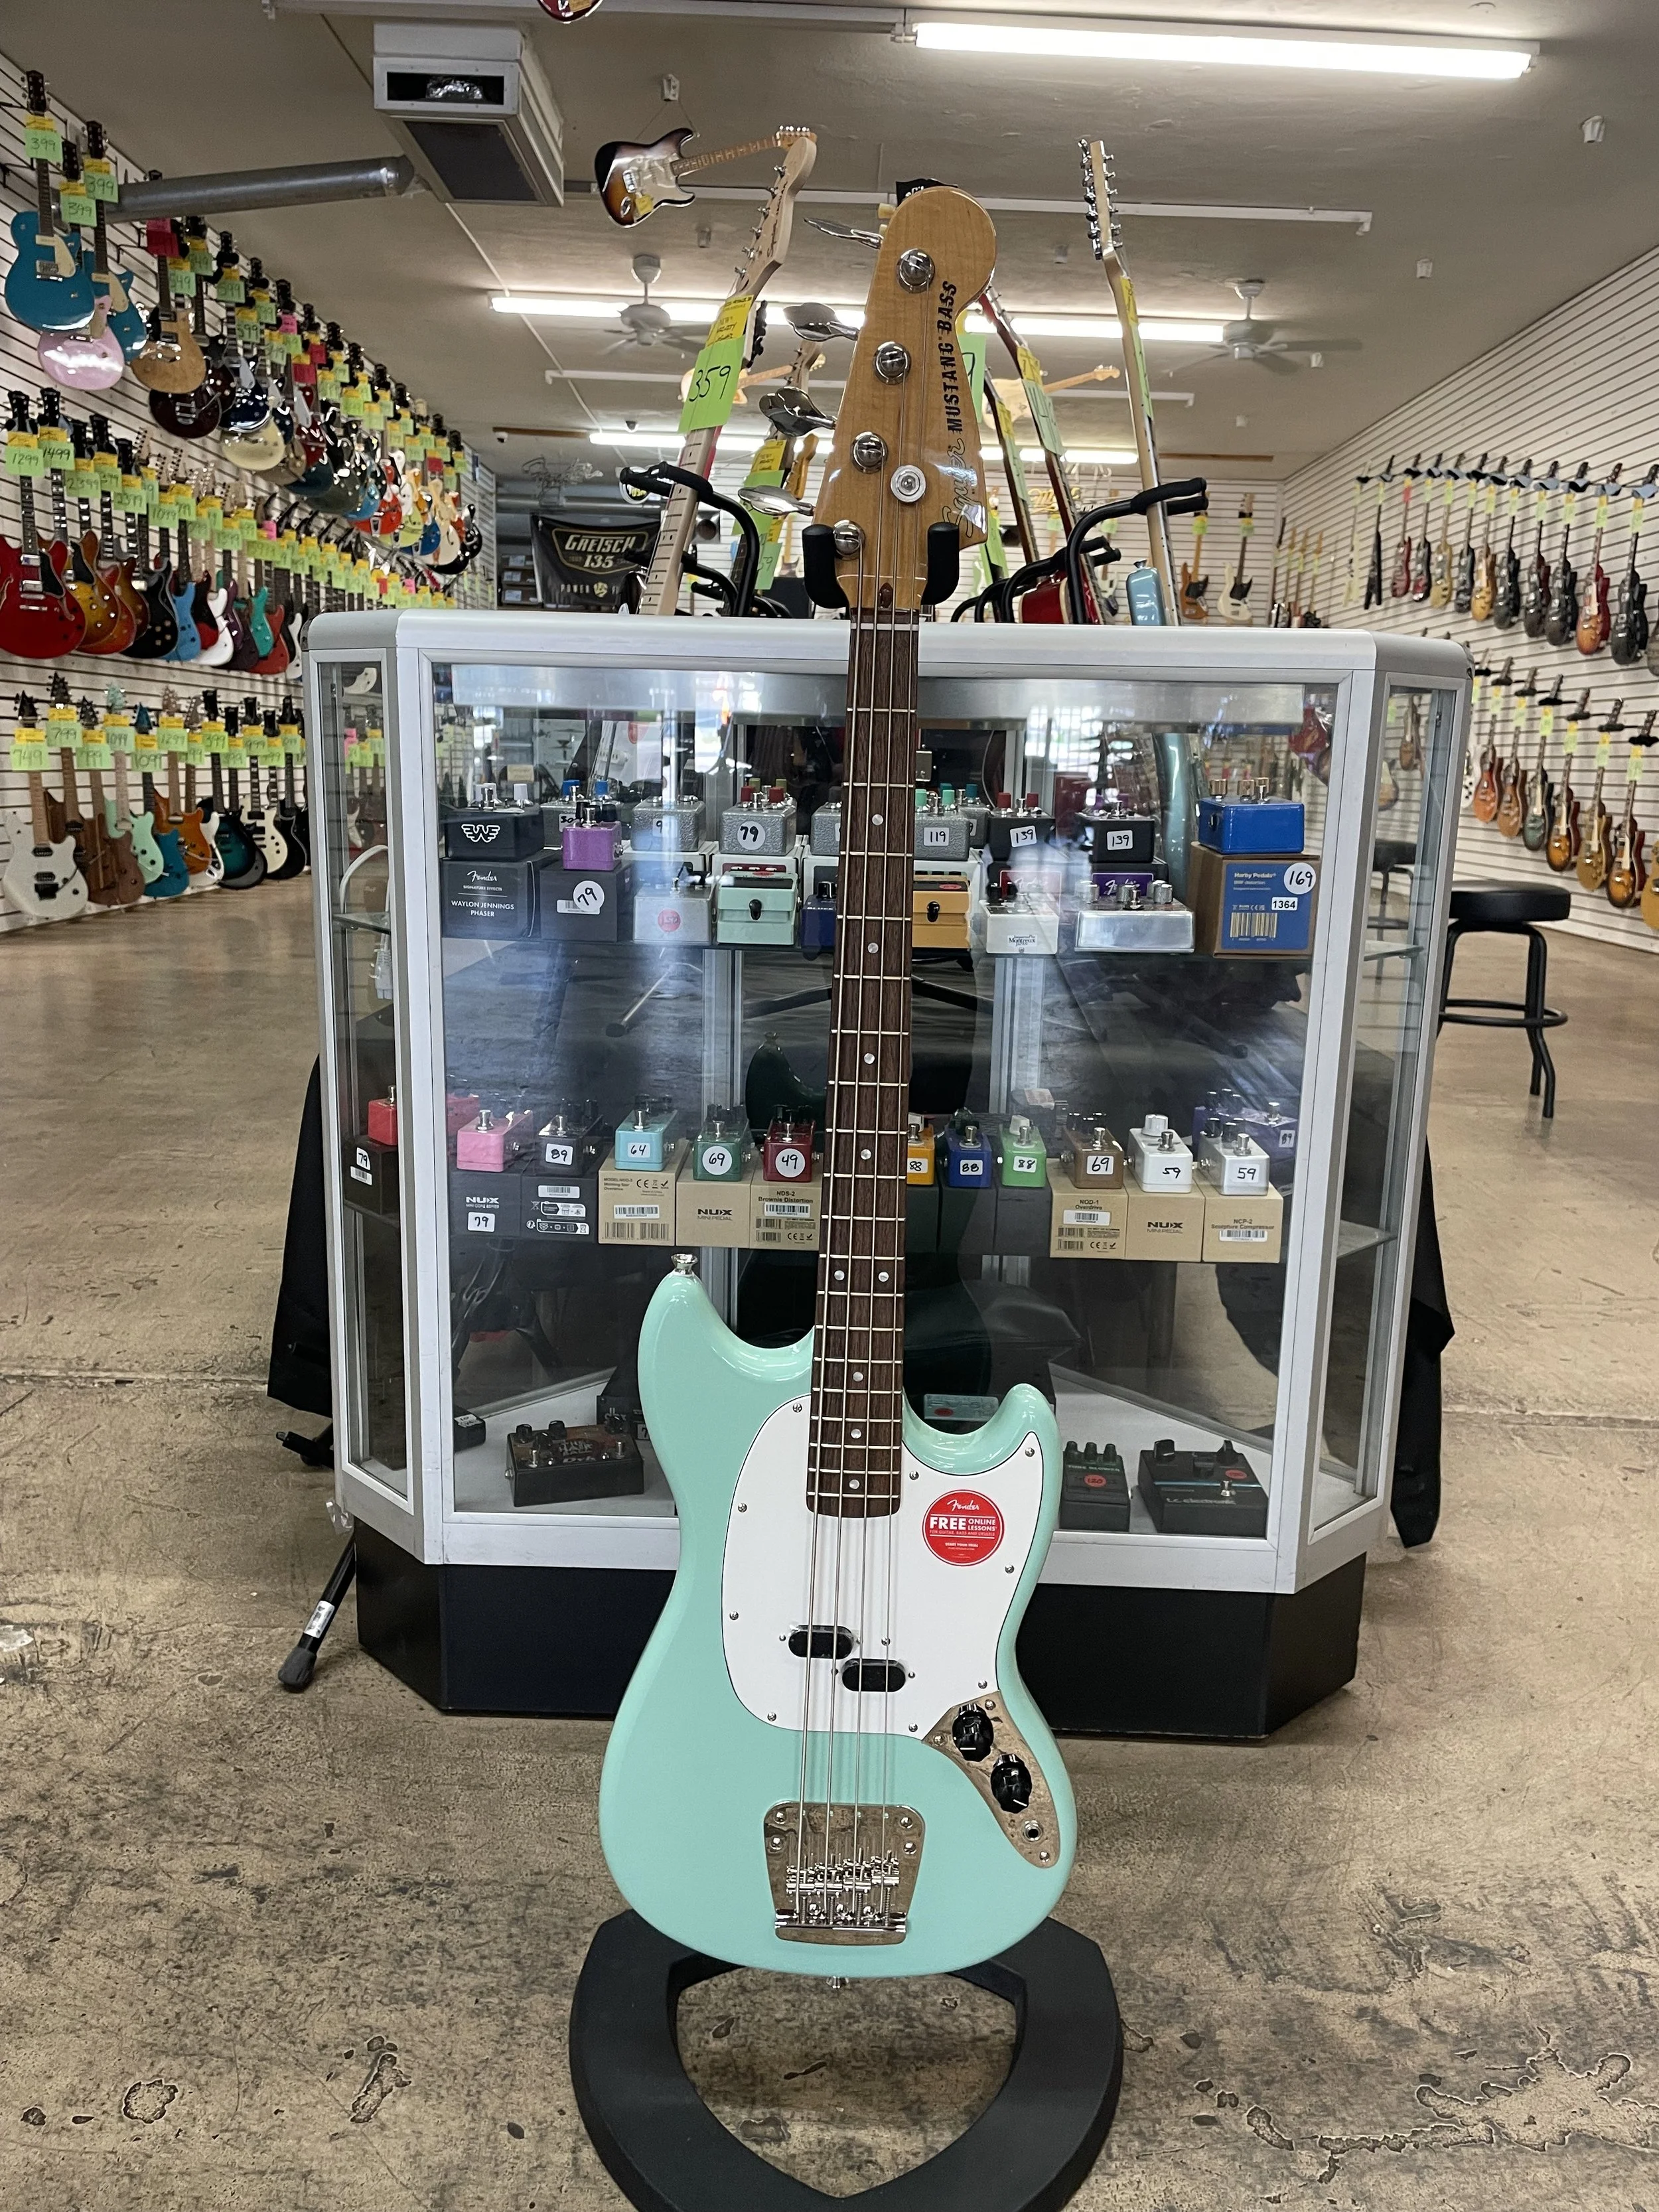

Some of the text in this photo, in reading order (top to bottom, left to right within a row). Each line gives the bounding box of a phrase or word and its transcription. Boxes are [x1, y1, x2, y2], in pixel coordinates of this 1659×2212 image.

[31, 137, 56, 152] 399
[937, 281, 963, 434] MUSTANG BASS
[689, 365, 731, 402] 359
[12, 453, 38, 466] 1299
[43, 447, 70, 461] 1499
[565, 534, 637, 553] GRETSCH
[583, 554, 614, 569] 135
[13, 749, 42, 766] 749
[739, 826, 759, 842] 79
[930, 830, 946, 843] 119
[1015, 829, 1034, 844] 139
[1112, 834, 1129, 847] 139
[467, 870, 498, 882] Fender
[1289, 871, 1313, 887] 169
[577, 887, 597, 906] 79
[1272, 900, 1296, 909] 1364
[551, 1149, 568, 1162] 89
[630, 1145, 646, 1156] 64
[358, 1153, 368, 1166] 79
[709, 1153, 725, 1167] 69
[781, 1154, 798, 1169] 49
[909, 1161, 922, 1171] 88
[1092, 1157, 1110, 1172] 69
[1163, 1167, 1181, 1179] 59
[1237, 1167, 1257, 1181] 59
[474, 1216, 489, 1228] 79
[946, 1499, 980, 1512] Fender
[930, 1516, 967, 1530] FREE
